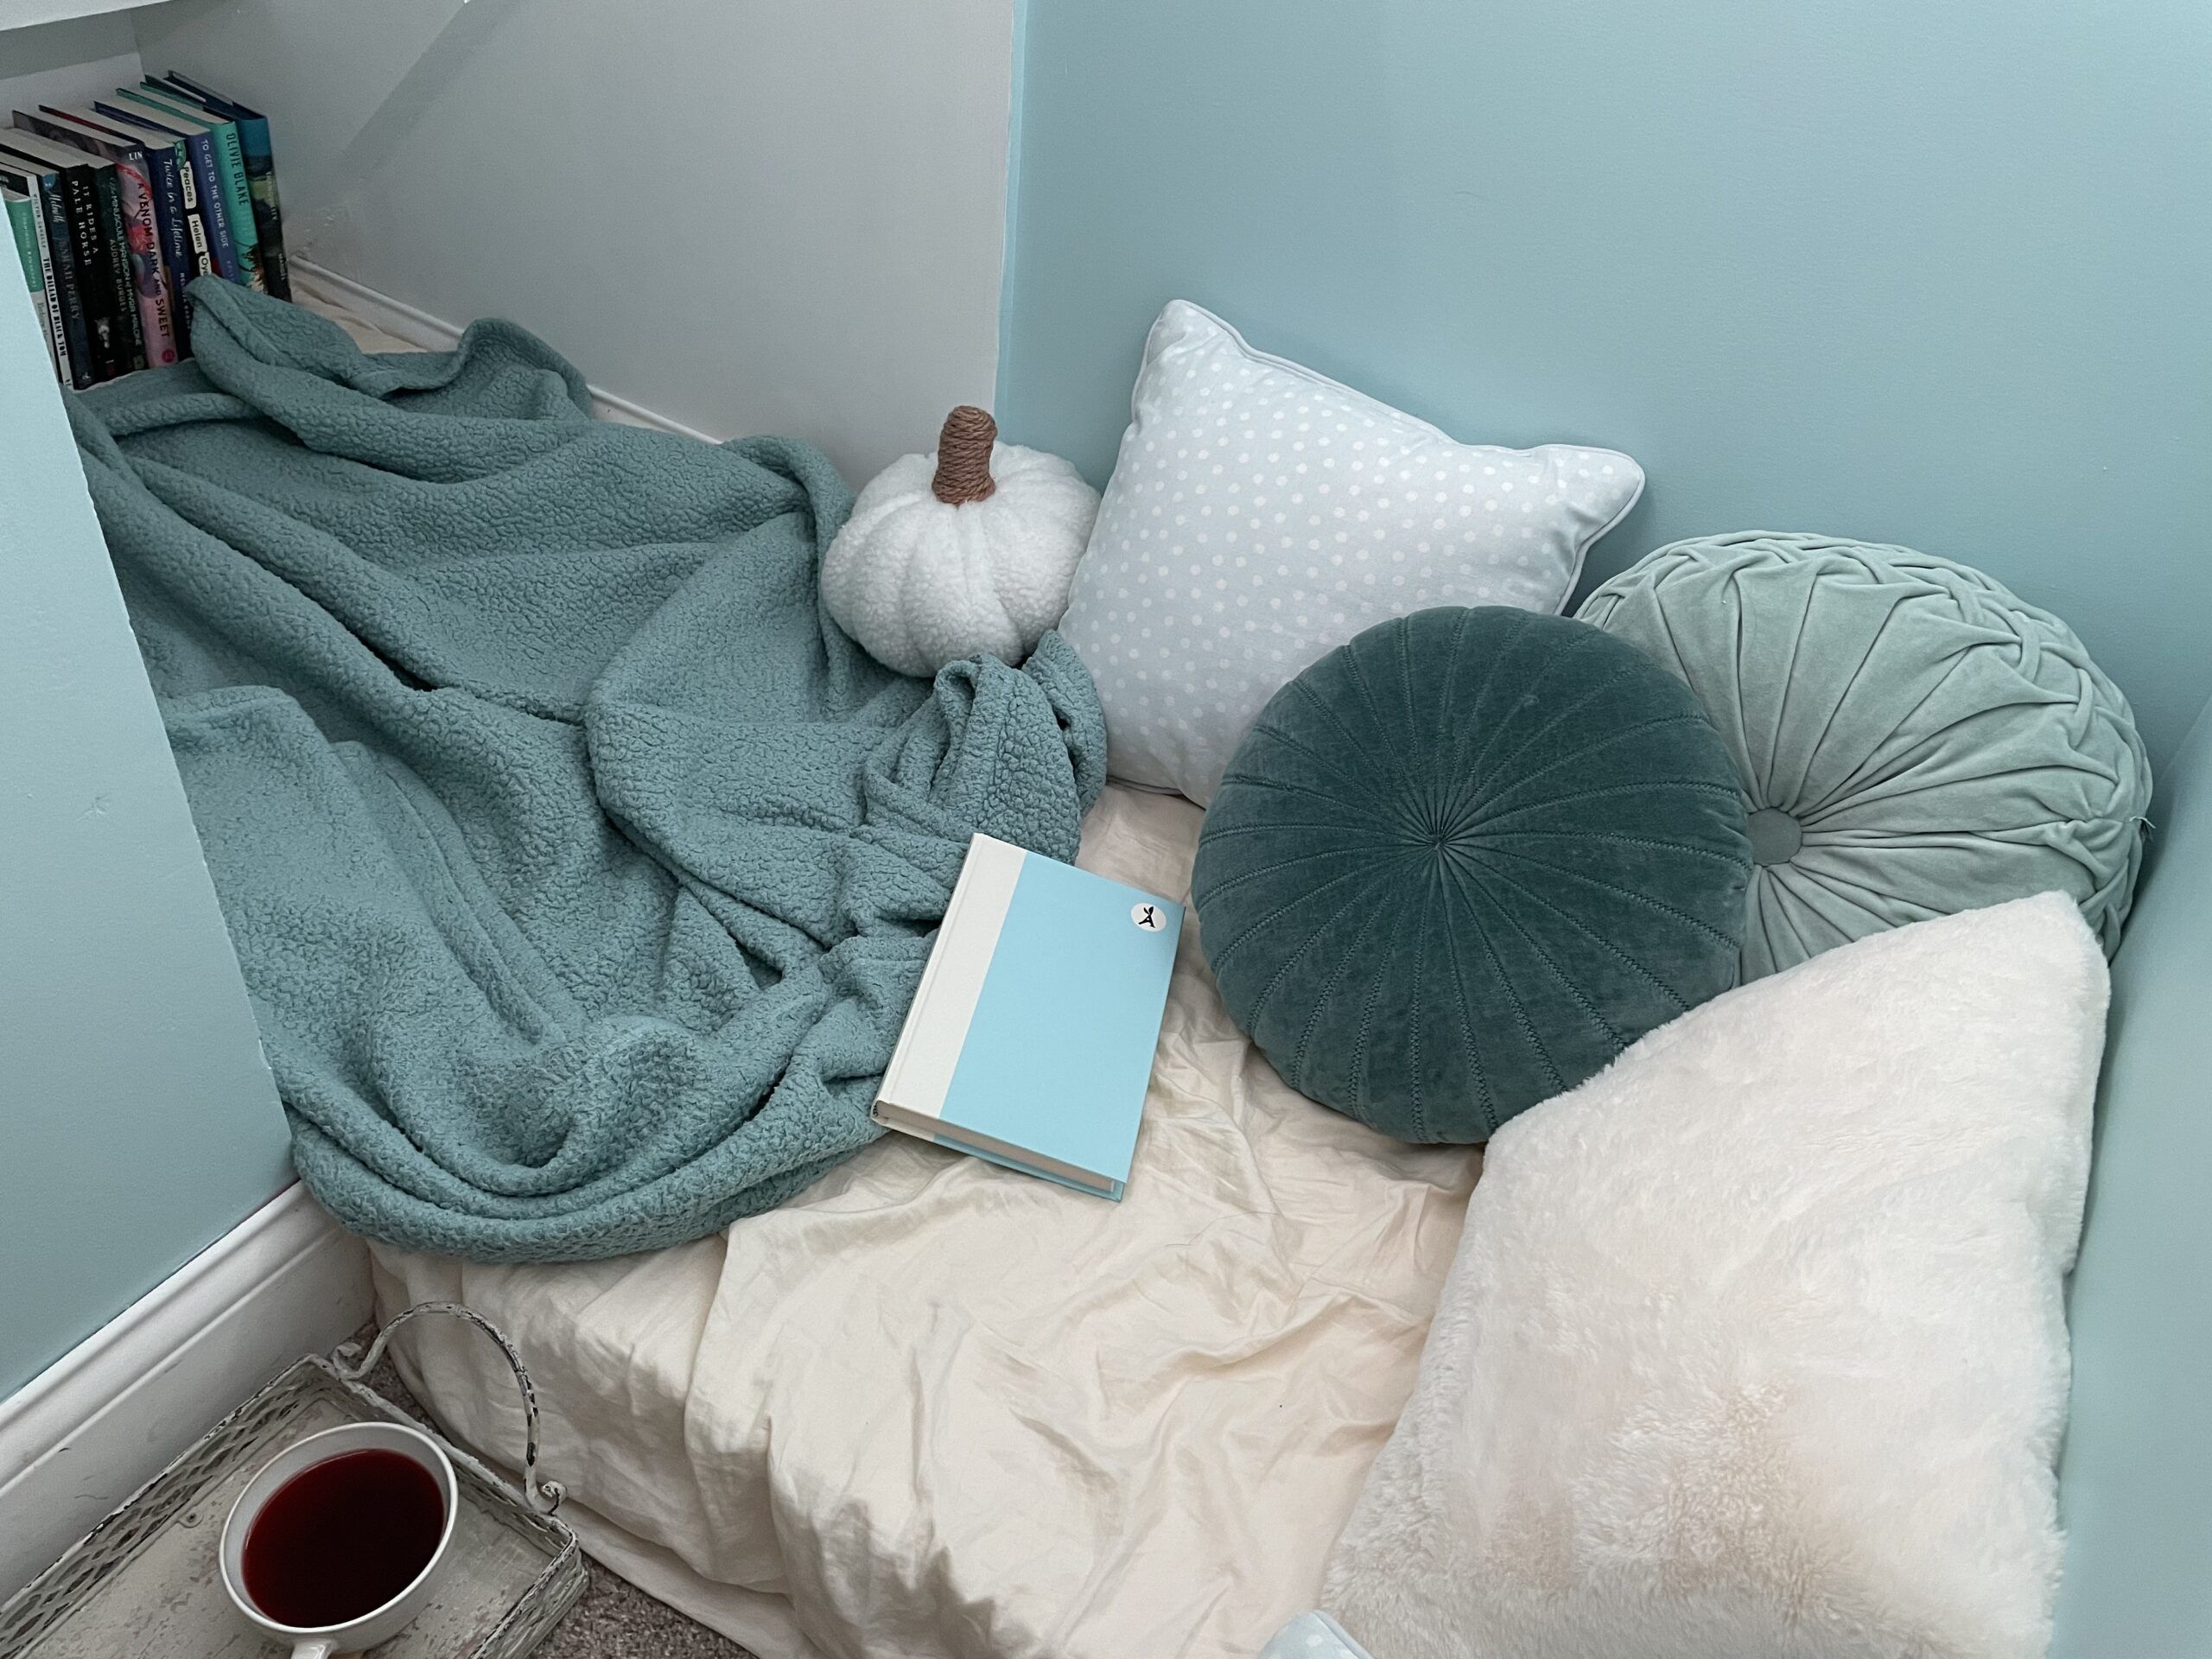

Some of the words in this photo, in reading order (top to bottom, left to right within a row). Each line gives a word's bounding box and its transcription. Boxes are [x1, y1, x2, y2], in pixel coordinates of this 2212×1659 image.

[129, 152, 143, 161] LIN
[200, 140, 209, 150] TO
[226, 133, 241, 168] OLIVIE
[204, 154, 213, 168] GET
[208, 171, 216, 181] TO
[183, 168, 194, 202] Peaces
[210, 184, 219, 200] THE
[233, 172, 250, 206] BLAKE
[72, 181, 83, 213] PALE
[78, 221, 92, 265] HORSE
[82, 186, 90, 196] IT
[86, 204, 97, 241] RIDES
[162, 159, 174, 188] Twice
[170, 218, 184, 258] Lifetime
[213, 202, 225, 228] OTHER
[191, 220, 202, 248] Helen
[139, 194, 152, 237] VENOM
[146, 242, 160, 275] DARK
[156, 298, 170, 337] SWEET
